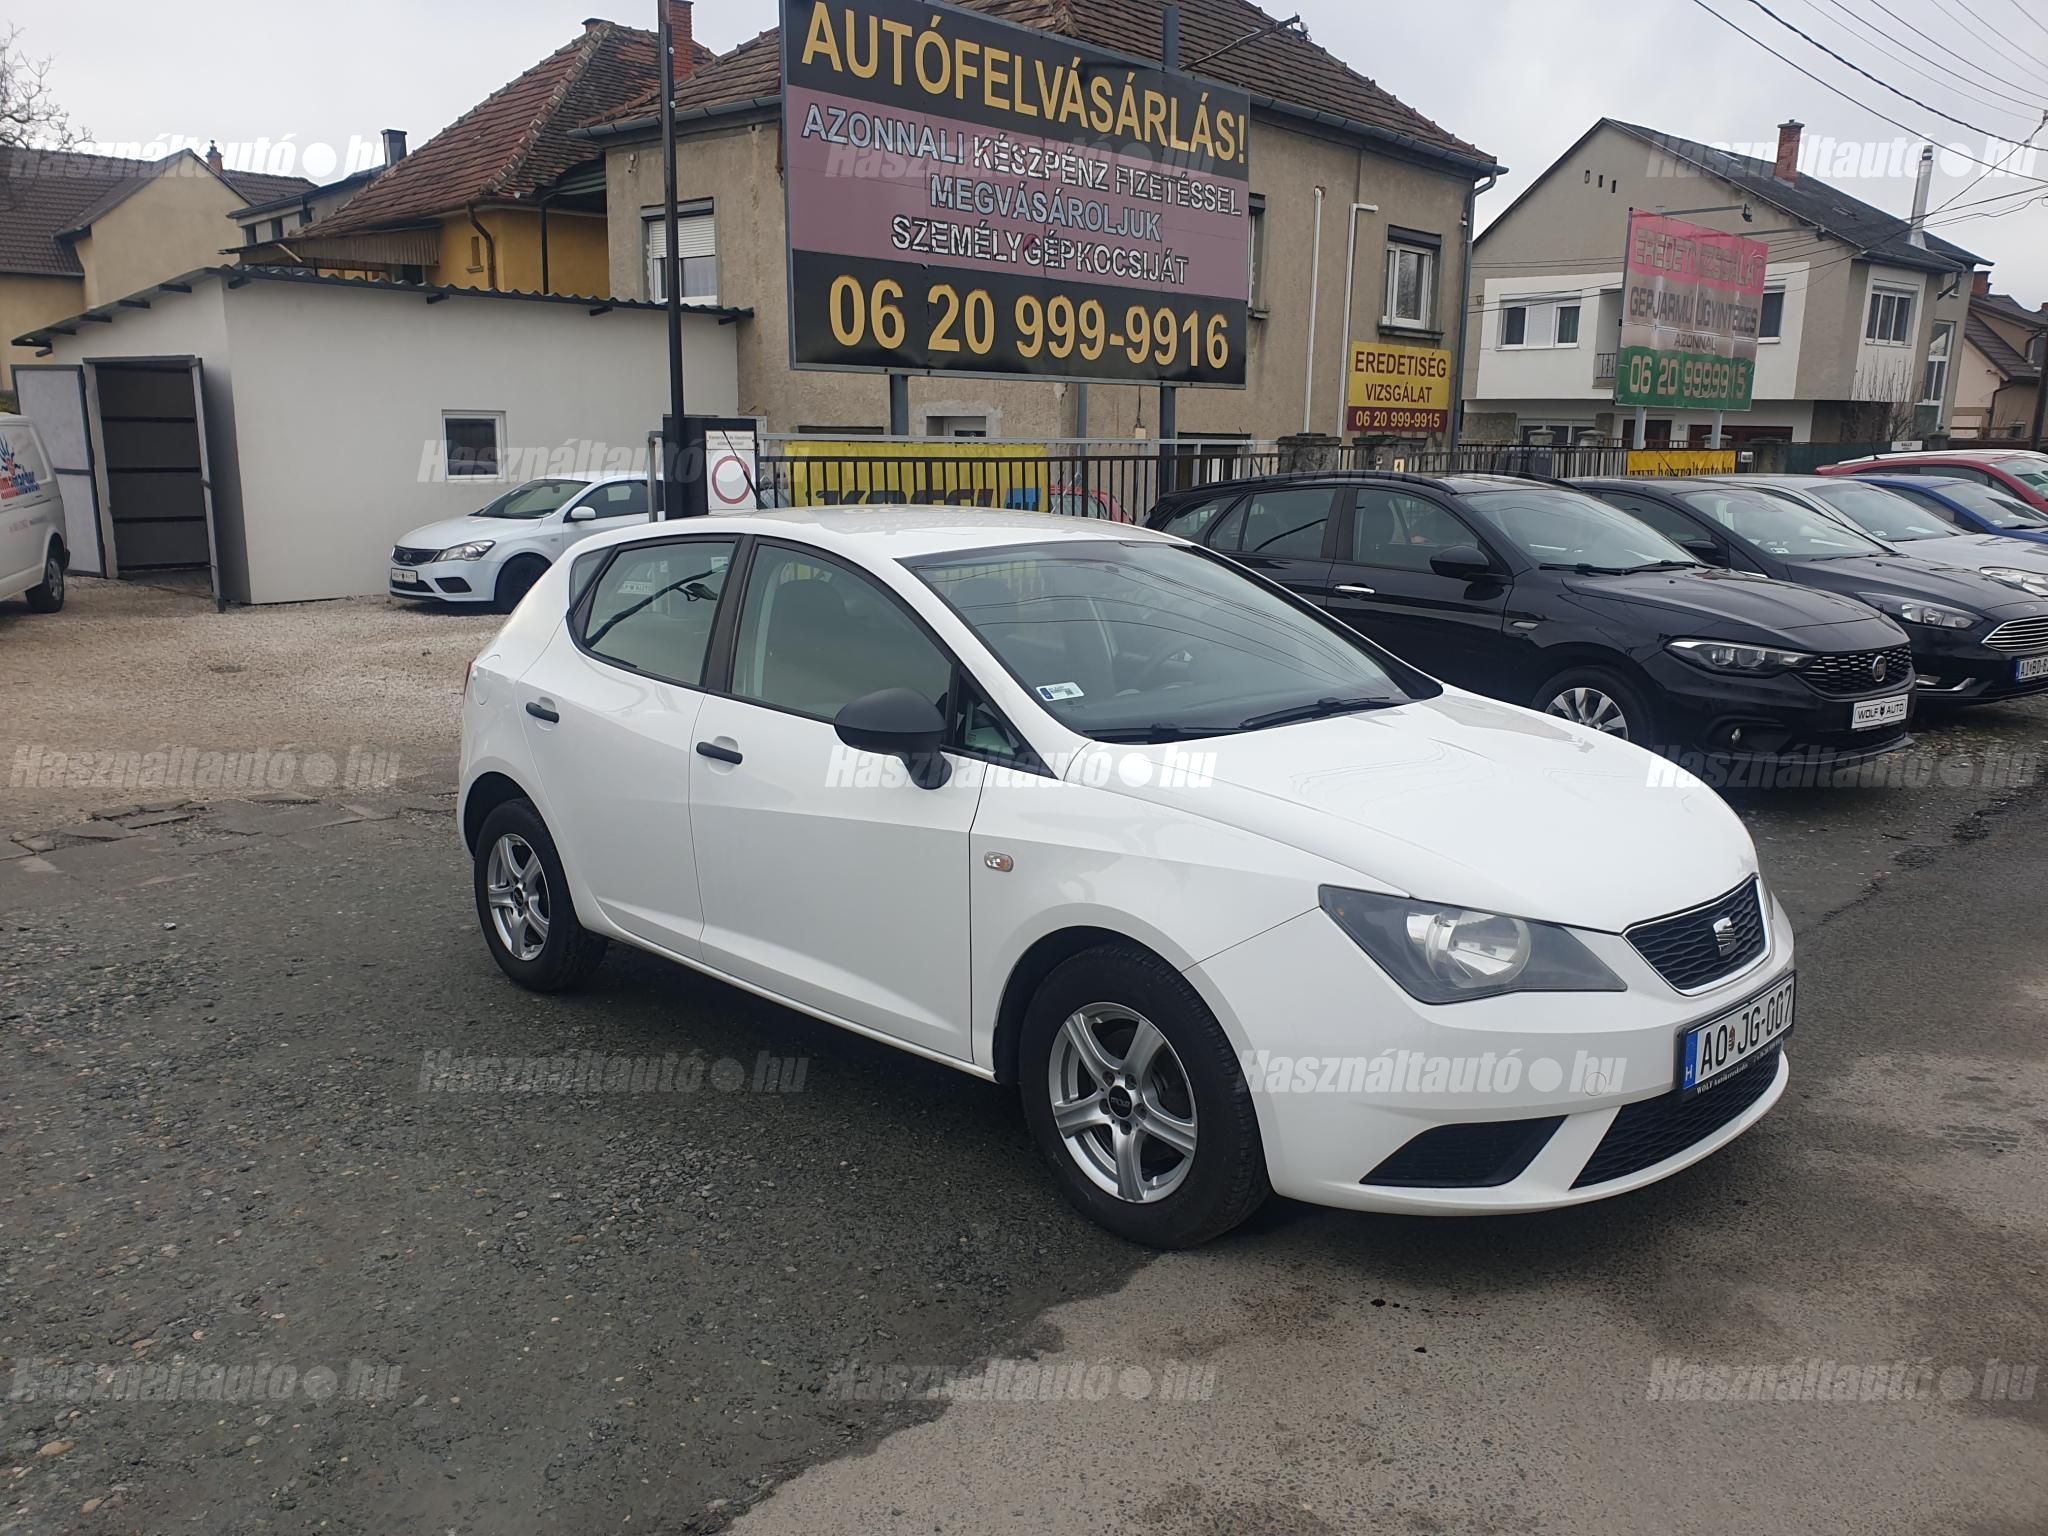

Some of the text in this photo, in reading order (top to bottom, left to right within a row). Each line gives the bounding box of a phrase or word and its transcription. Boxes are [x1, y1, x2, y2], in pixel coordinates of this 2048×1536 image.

[801, 2, 1246, 163] AUTÓFELVÁSÁRLÁS!
[802, 104, 1242, 215] AZONNALI KÉSZPÉNZ FIZETÉSSEL
[930, 174, 1162, 241] MEGVÁSÁROLJUK
[891, 216, 1189, 284] SZEMÉLYGÉPKOCSIJÁT
[828, 274, 1229, 368] 06 20 999-9916
[1355, 351, 1447, 378] EREDETISÉG
[1630, 355, 1652, 394] 06
[1657, 358, 1679, 395] 20
[1356, 410, 1440, 428] 06 20 999-9915
[1366, 382, 1432, 403] VIZSGÁLAT
[1857, 703, 1904, 720] WOLF AUTO
